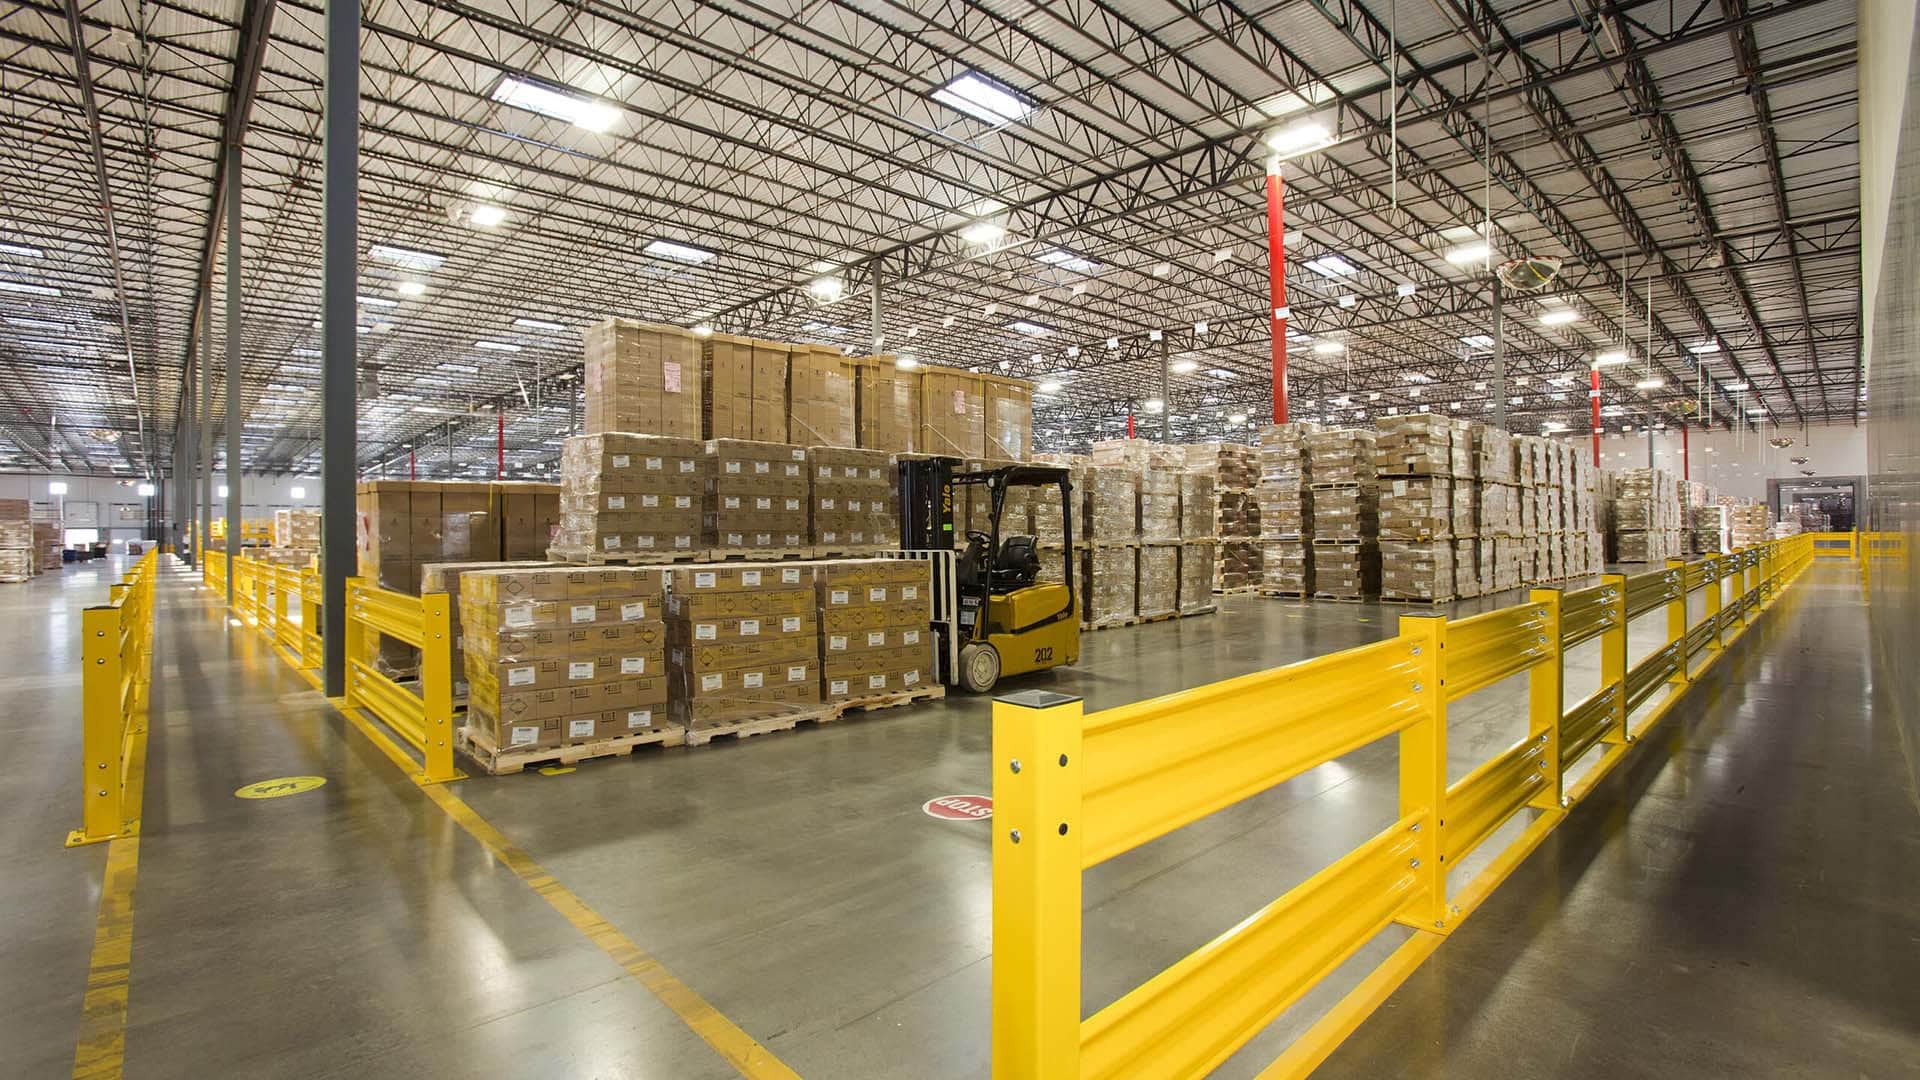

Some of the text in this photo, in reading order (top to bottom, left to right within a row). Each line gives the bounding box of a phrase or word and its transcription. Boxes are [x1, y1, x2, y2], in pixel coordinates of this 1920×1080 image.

[942, 484, 952, 513] Yale
[1035, 647, 1053, 663] 202
[935, 799, 992, 817] STOP
